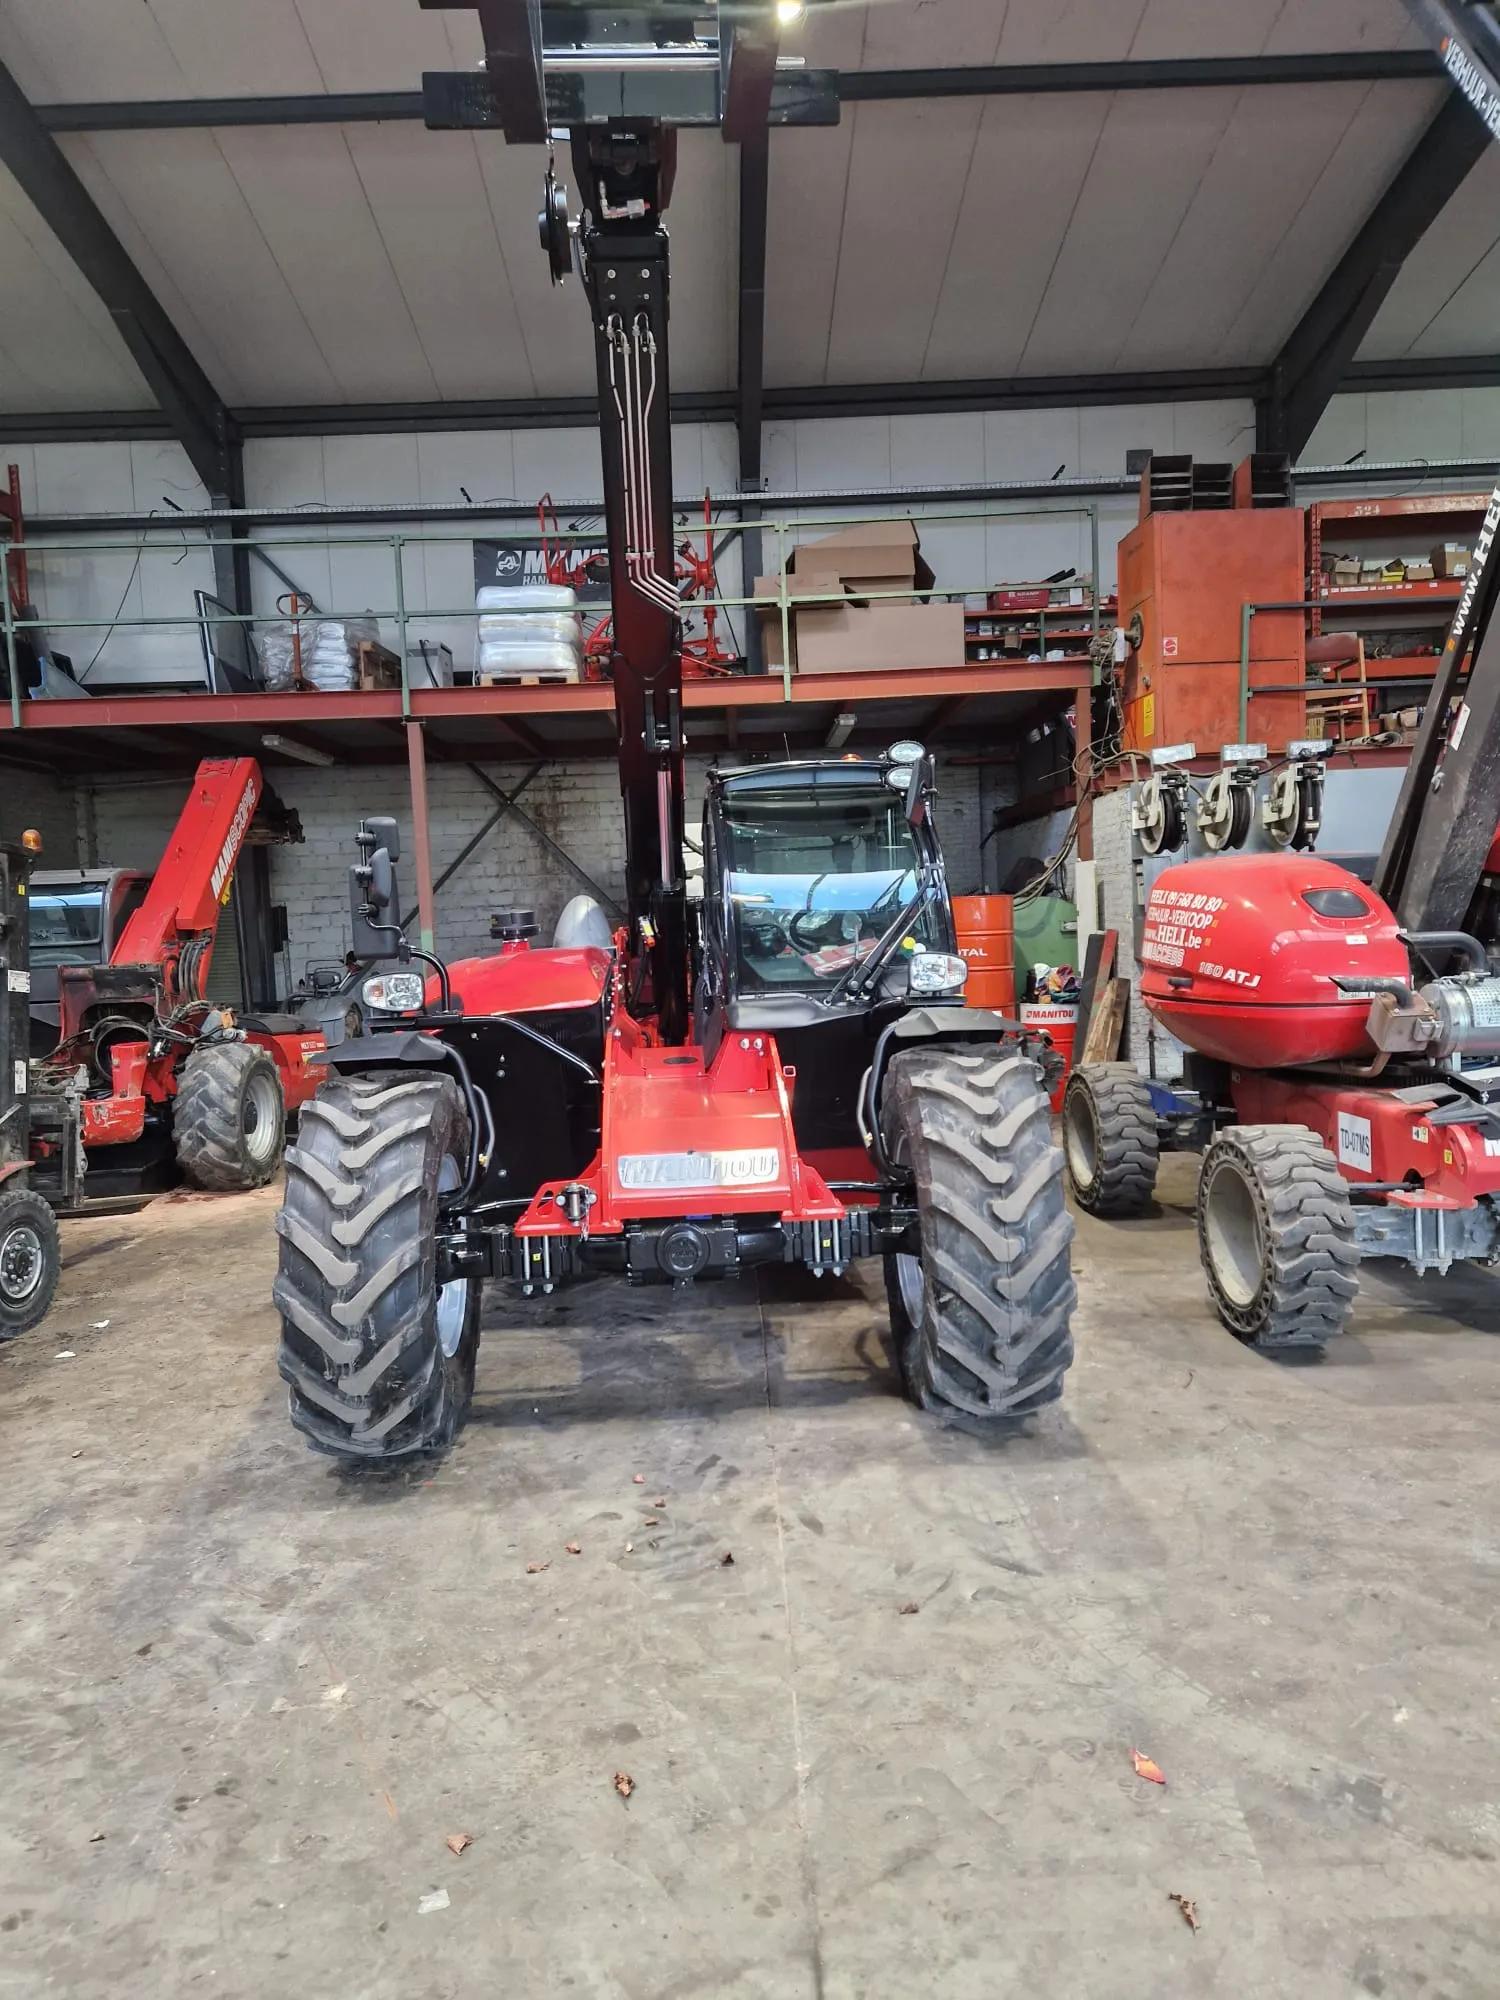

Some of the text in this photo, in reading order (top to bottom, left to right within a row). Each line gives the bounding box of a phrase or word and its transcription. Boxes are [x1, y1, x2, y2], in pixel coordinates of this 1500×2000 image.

[1191, 894, 1207, 910] 80
[1204, 896, 1222, 912] 80
[957, 948, 988, 957] TAL
[1223, 968, 1261, 987] ATJ
[1031, 1009, 1074, 1019] MANITOU
[624, 1155, 774, 1184] MANITOU
